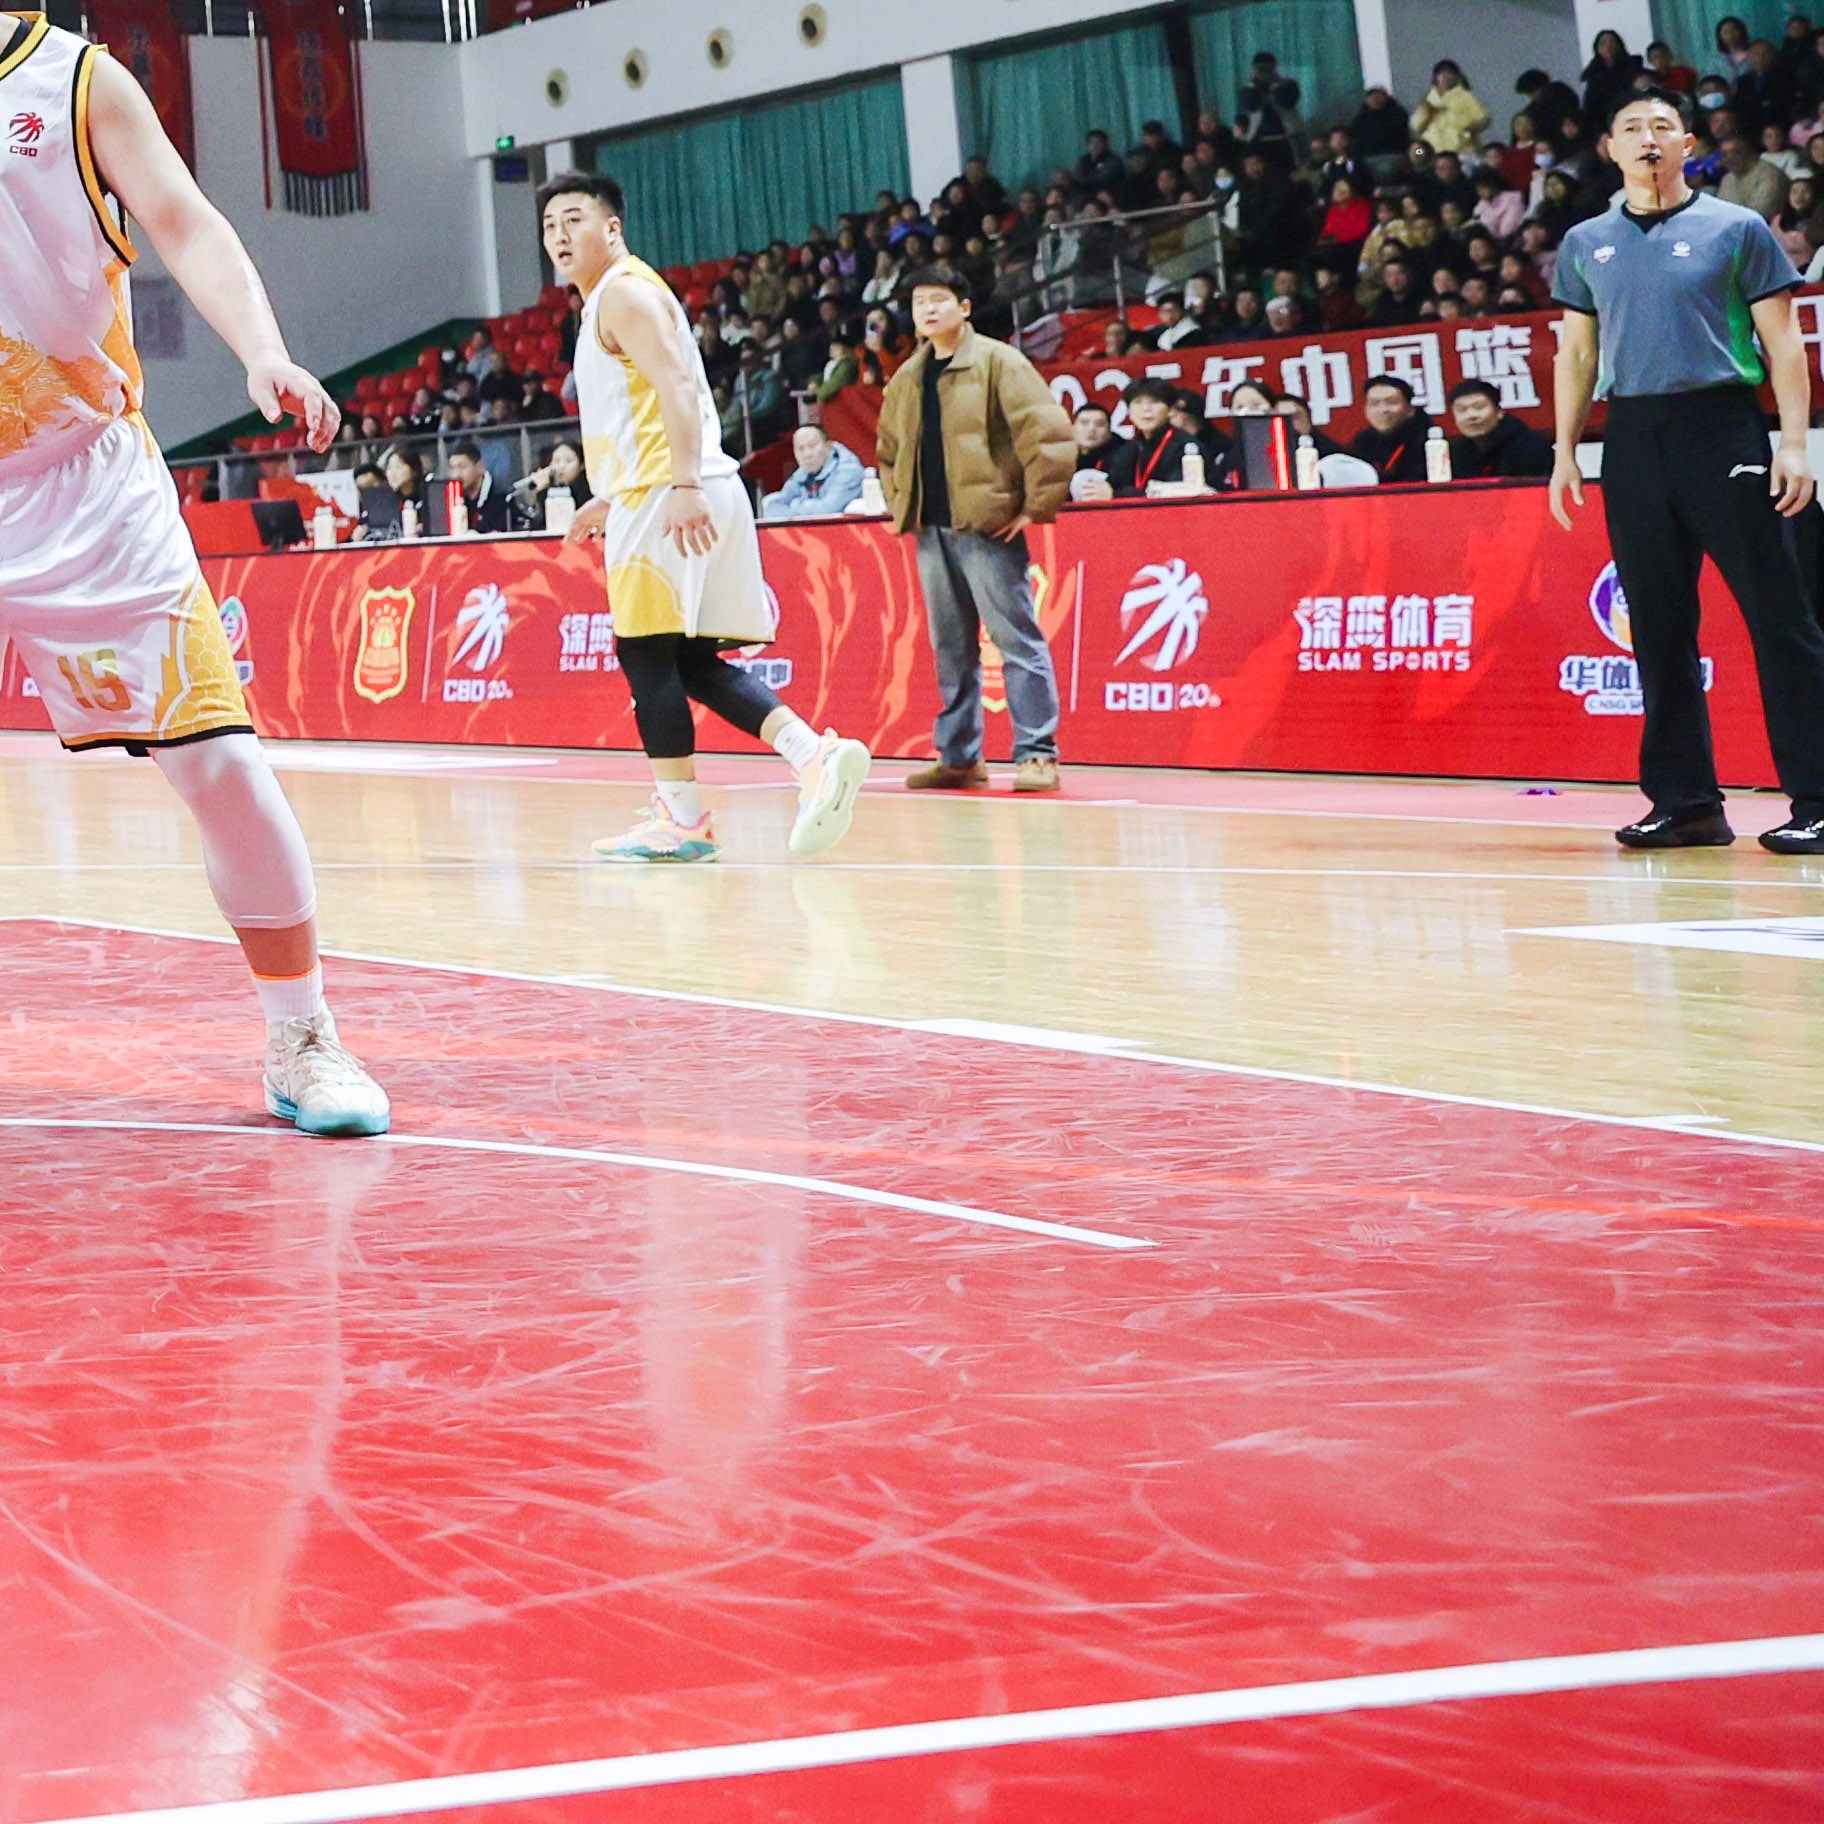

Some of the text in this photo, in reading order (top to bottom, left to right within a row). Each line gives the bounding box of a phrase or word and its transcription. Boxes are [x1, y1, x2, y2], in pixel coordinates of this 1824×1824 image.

[9, 145, 39, 158] CBO
[1293, 594, 1474, 649] 深篮体育
[1298, 651, 1471, 672] SLAM SPORTS
[58, 649, 133, 713] 19
[1104, 682, 1173, 712] CBO
